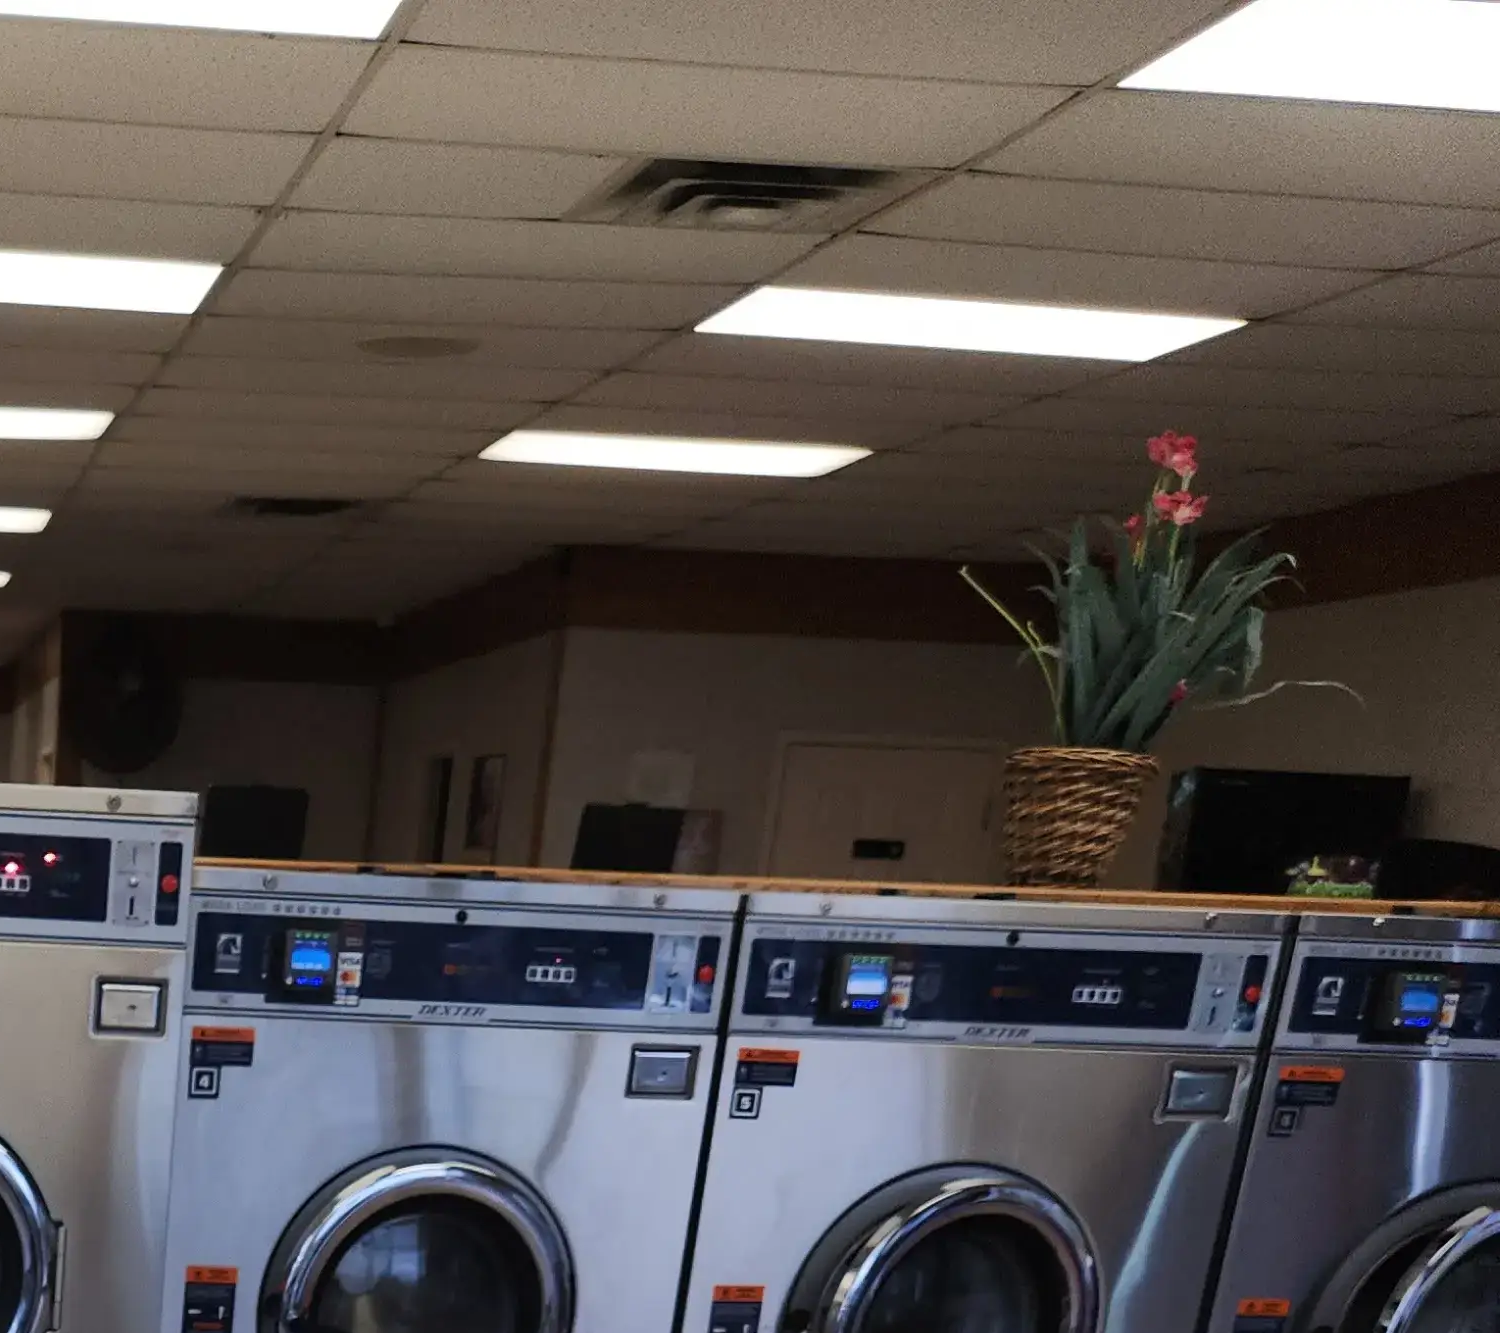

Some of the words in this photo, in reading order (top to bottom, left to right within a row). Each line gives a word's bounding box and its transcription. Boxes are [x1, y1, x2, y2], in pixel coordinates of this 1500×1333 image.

[418, 1004, 489, 1018] DEXTER
[964, 1026, 1032, 1039] DEXTER
[198, 1074, 210, 1089] 4
